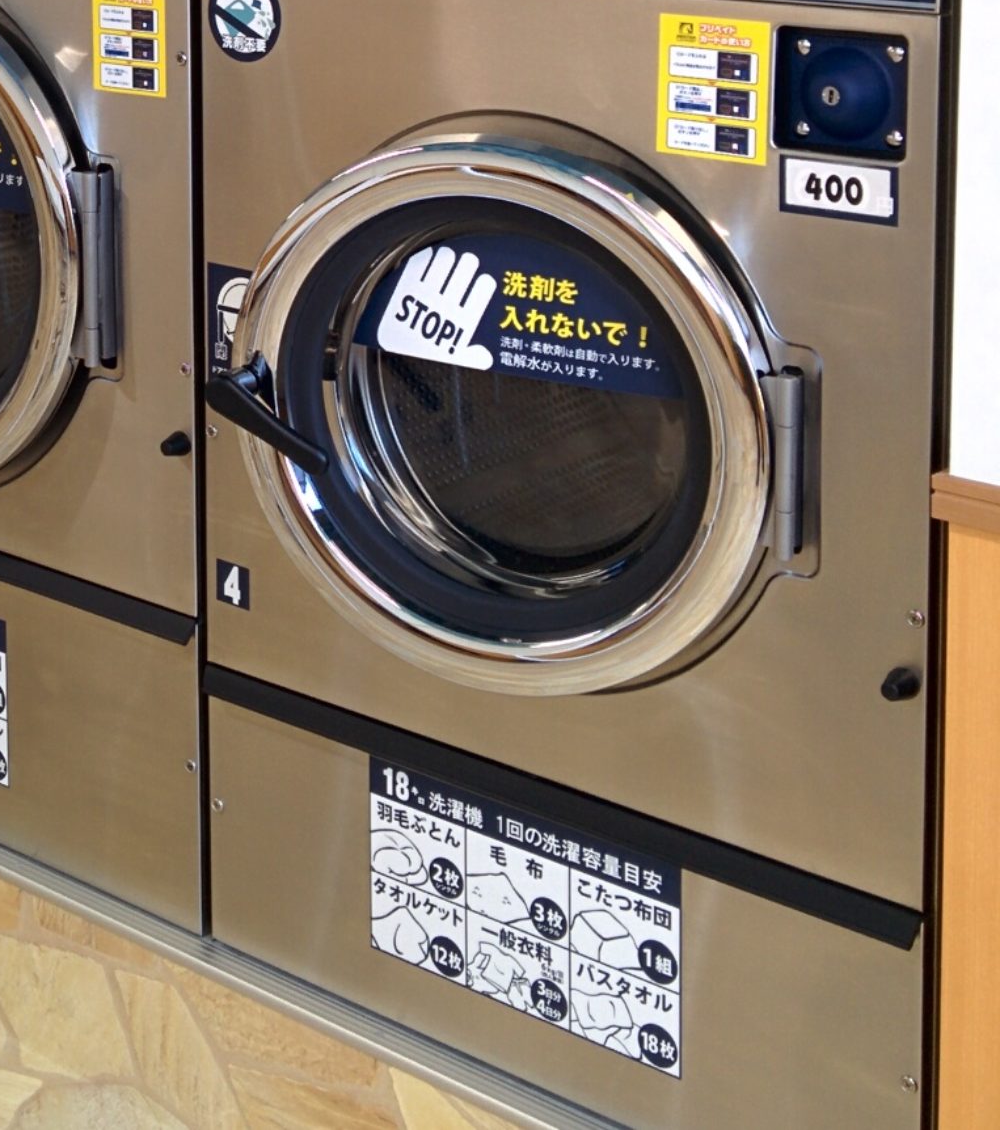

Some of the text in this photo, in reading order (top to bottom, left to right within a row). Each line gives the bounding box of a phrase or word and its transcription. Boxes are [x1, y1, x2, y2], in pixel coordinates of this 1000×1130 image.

[805, 172, 864, 206] 400
[502, 271, 579, 305] 洗剤を
[395, 294, 464, 355] STOP!
[500, 352, 604, 381] 電解水が入ります。
[224, 565, 241, 606] 4
[376, 801, 461, 848] 羽毛ぶとん
[496, 814, 662, 894] 1回の洗濯容量目安
[432, 863, 460, 889] 2枚
[372, 878, 463, 927] タオルケット
[532, 902, 563, 930] 3枚
[577, 880, 672, 930] こたつ布団
[431, 943, 462, 972] 12枚
[480, 926, 554, 965] 一般衣料
[641, 948, 673, 978] 1組
[577, 963, 673, 1012] バスタオル
[641, 1032, 676, 1060] 18枚
